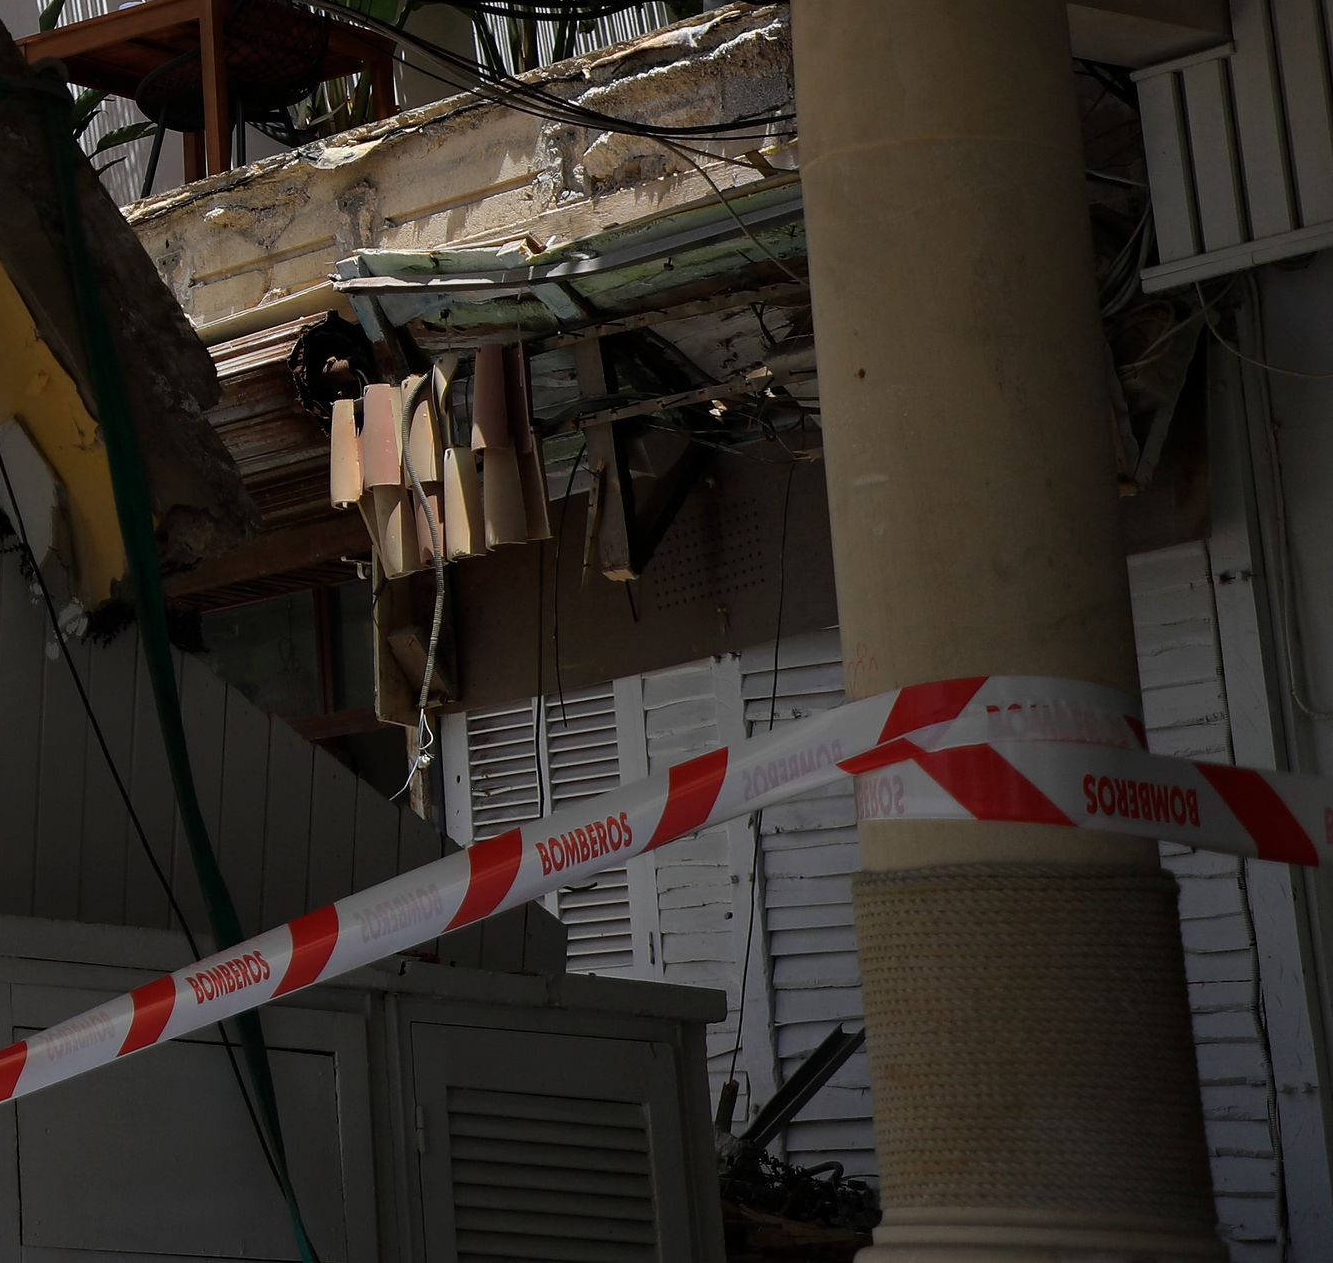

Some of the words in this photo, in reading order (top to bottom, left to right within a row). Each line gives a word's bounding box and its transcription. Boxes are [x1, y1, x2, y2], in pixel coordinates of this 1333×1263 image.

[1083, 773, 1200, 828] BOMBEROS
[536, 812, 633, 876] BOMBEROS
[185, 950, 271, 1005] BOMBEROS
